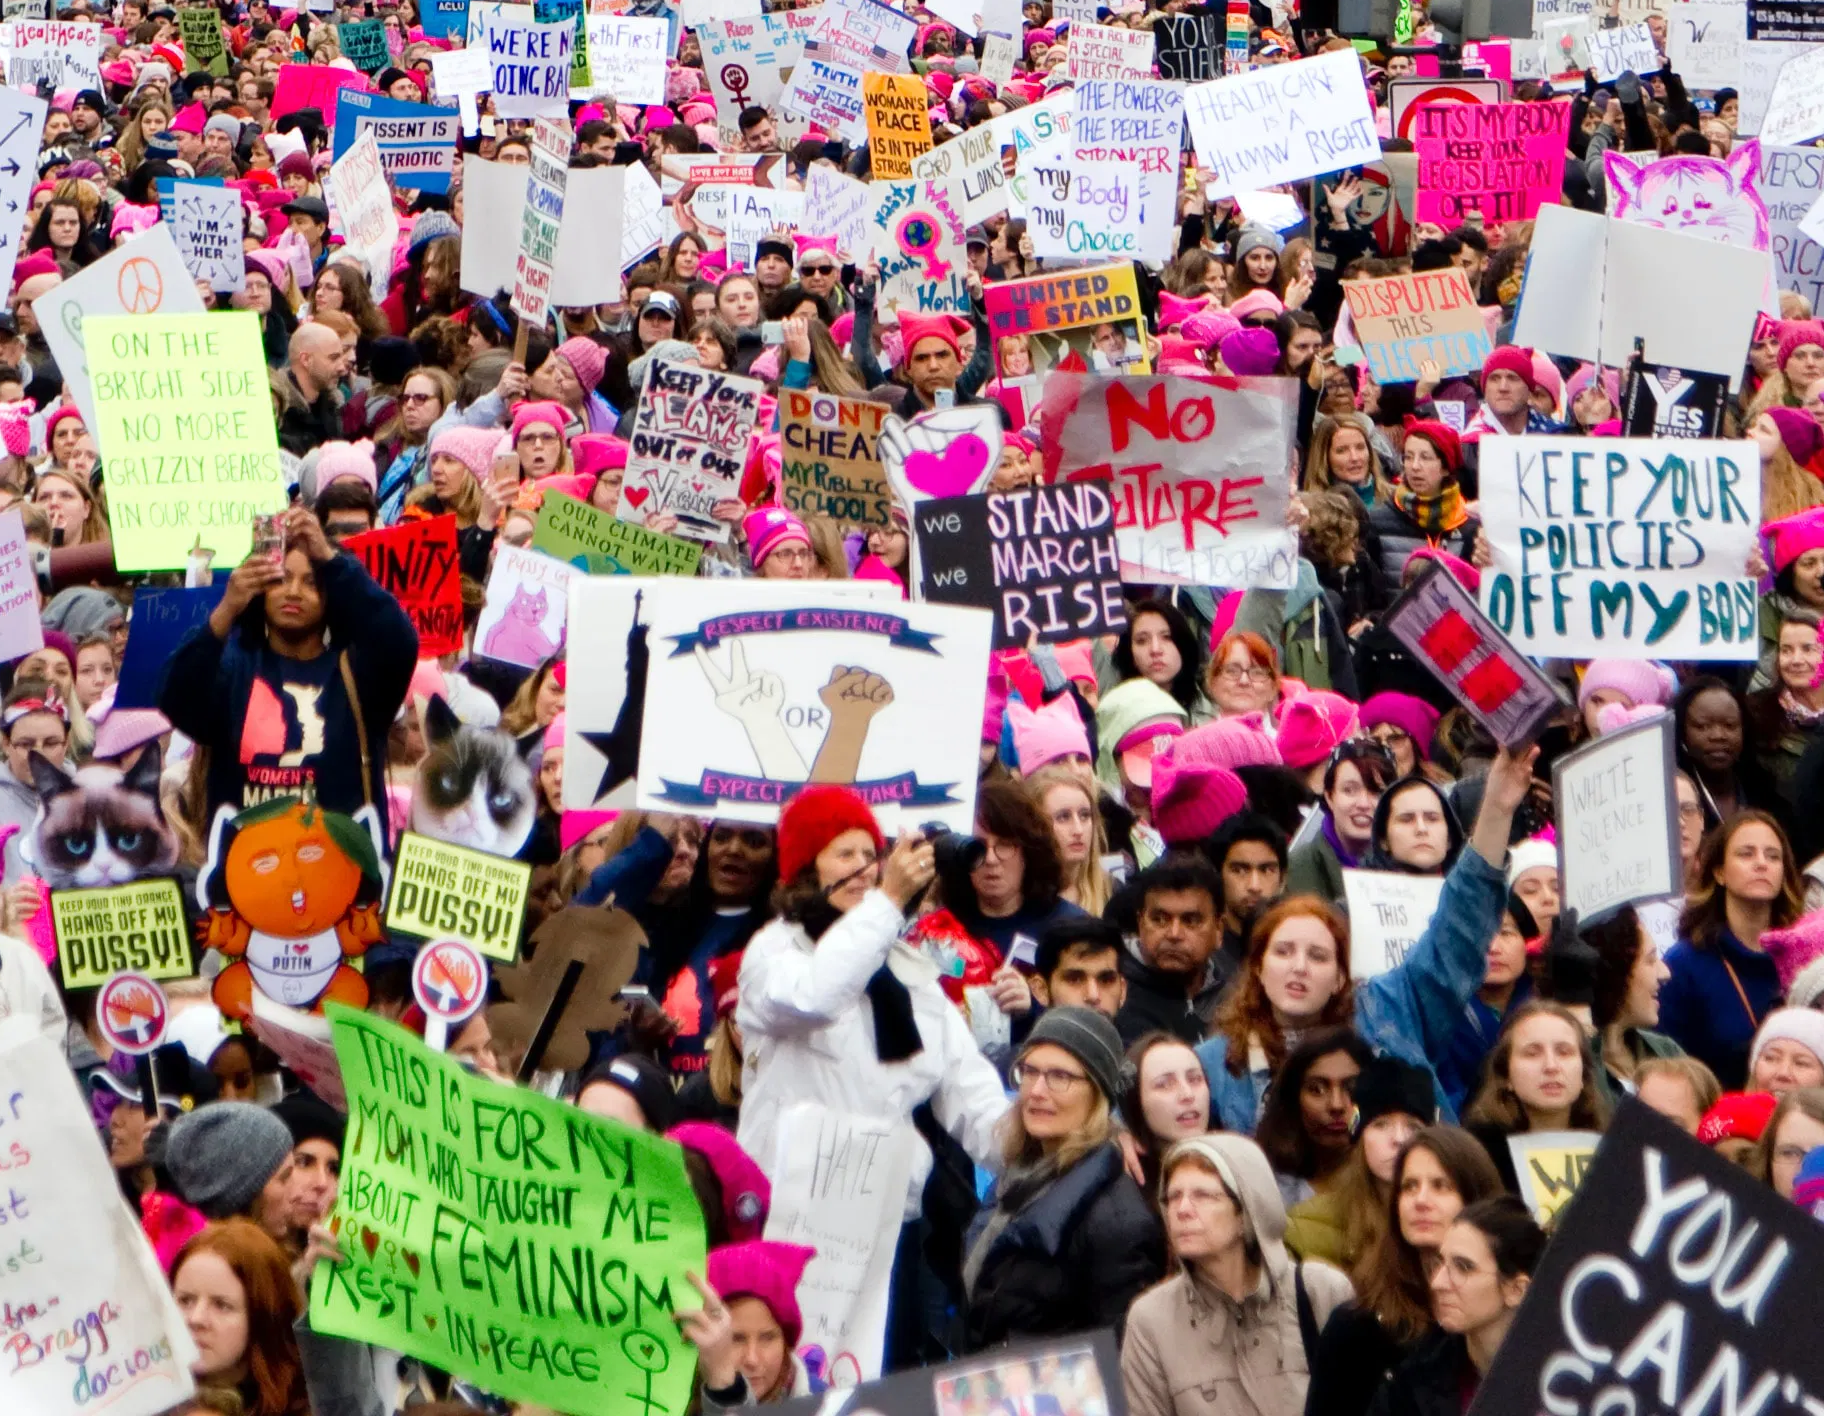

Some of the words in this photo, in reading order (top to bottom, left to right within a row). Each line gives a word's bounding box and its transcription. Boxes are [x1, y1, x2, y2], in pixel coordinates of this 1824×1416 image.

[1476, 107, 1506, 134] MY
[1517, 103, 1566, 131] BODY
[1447, 140, 1485, 159] KEEP
[1490, 141, 1524, 157] YOUR
[1419, 159, 1550, 191] LEGISLATION
[1441, 193, 1482, 220] OFF
[1010, 277, 1108, 308] UNITED
[993, 310, 1035, 329] WE
[1047, 296, 1132, 324] STAND
[112, 332, 147, 358] ON
[159, 330, 220, 356] THE
[95, 371, 188, 402] BRIGHT
[201, 370, 257, 397] SIDE
[123, 414, 164, 443] NO
[177, 411, 249, 440] MORE
[109, 459, 204, 486] GRIZZLY
[215, 454, 278, 482] BEARS
[1519, 451, 1628, 518] KEEP
[1636, 454, 1750, 522] YOUR
[116, 504, 135, 529] IN
[142, 503, 190, 528] OUR
[925, 513, 961, 534] we
[988, 485, 1110, 536] STAND
[934, 567, 967, 586] we
[993, 535, 1117, 584] MARCH
[1522, 521, 1703, 569] POLICIES
[704, 612, 785, 638] RESPECT
[798, 611, 901, 634] EXISTENCE
[1003, 583, 1126, 636] RISE
[1490, 574, 1572, 634] OFF
[1591, 581, 1688, 643] MY
[1698, 579, 1757, 642] BODY
[786, 707, 824, 730] OR
[703, 776, 783, 800] EXPECT
[63, 914, 115, 932] HANDS
[121, 911, 150, 928] OFF
[156, 908, 177, 924] MY
[66, 928, 182, 977] PUSSY!
[272, 956, 311, 971] PUTIN
[342, 1022, 428, 1109] THIS
[439, 1071, 459, 1131] IS
[471, 1099, 560, 1172] FOR
[567, 1120, 634, 1187] MY
[350, 1097, 416, 1176] MOM
[421, 1138, 464, 1200] WHO
[468, 1169, 580, 1223] TAUGHT
[603, 1200, 670, 1243] ME
[343, 1172, 421, 1226] ABOUT
[431, 1204, 673, 1337] FEMINISM
[327, 1254, 416, 1332] REST
[443, 1305, 475, 1358] IN
[490, 1327, 601, 1383] PEACE
